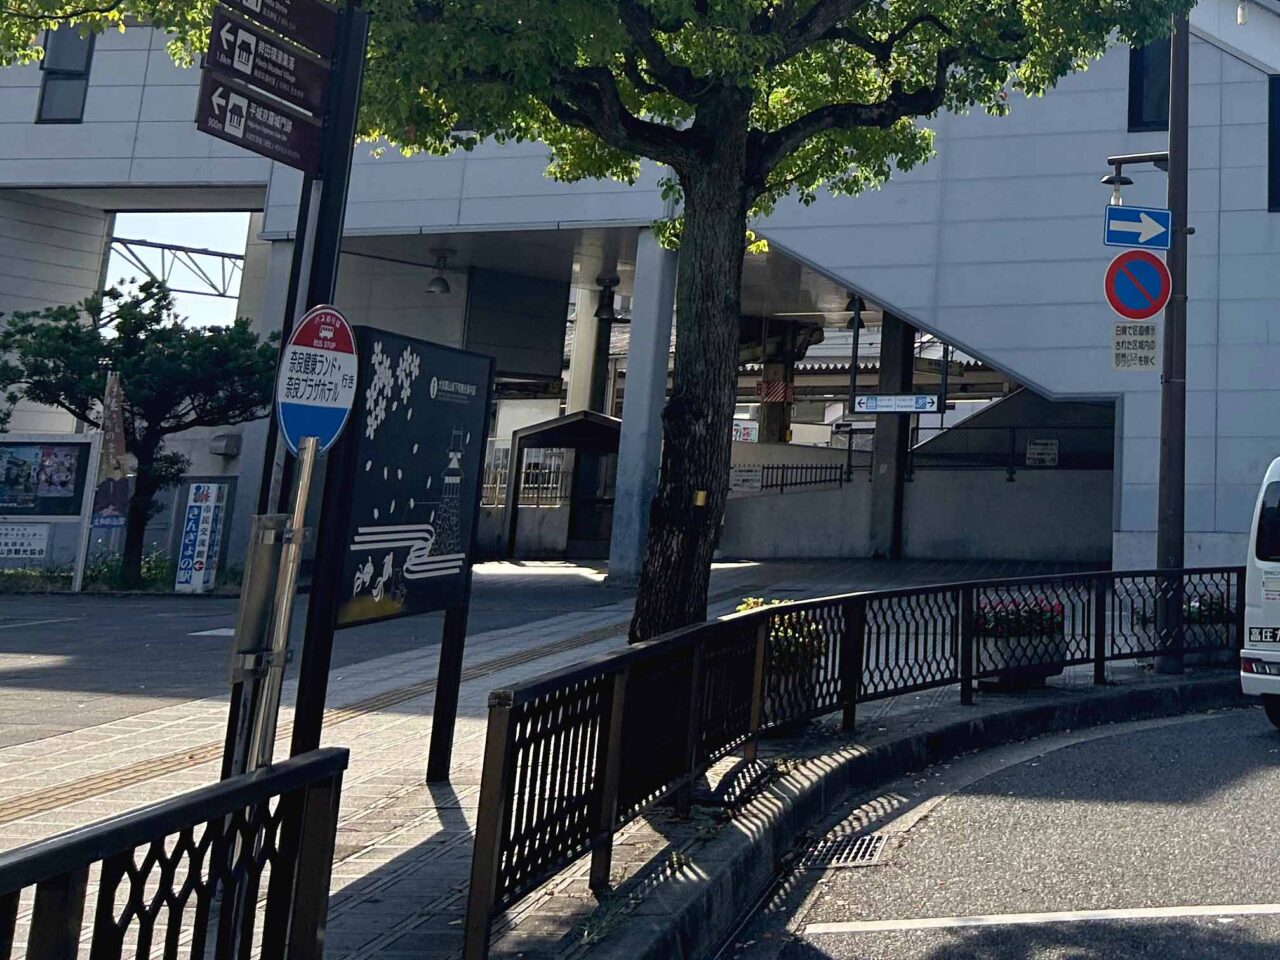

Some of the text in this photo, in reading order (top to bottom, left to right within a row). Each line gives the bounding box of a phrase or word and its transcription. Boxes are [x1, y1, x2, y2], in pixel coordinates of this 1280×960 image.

[313, 339, 337, 350] BUS STOP
[285, 376, 340, 402] 奈良プラザホテル
[341, 373, 355, 389] 行き
